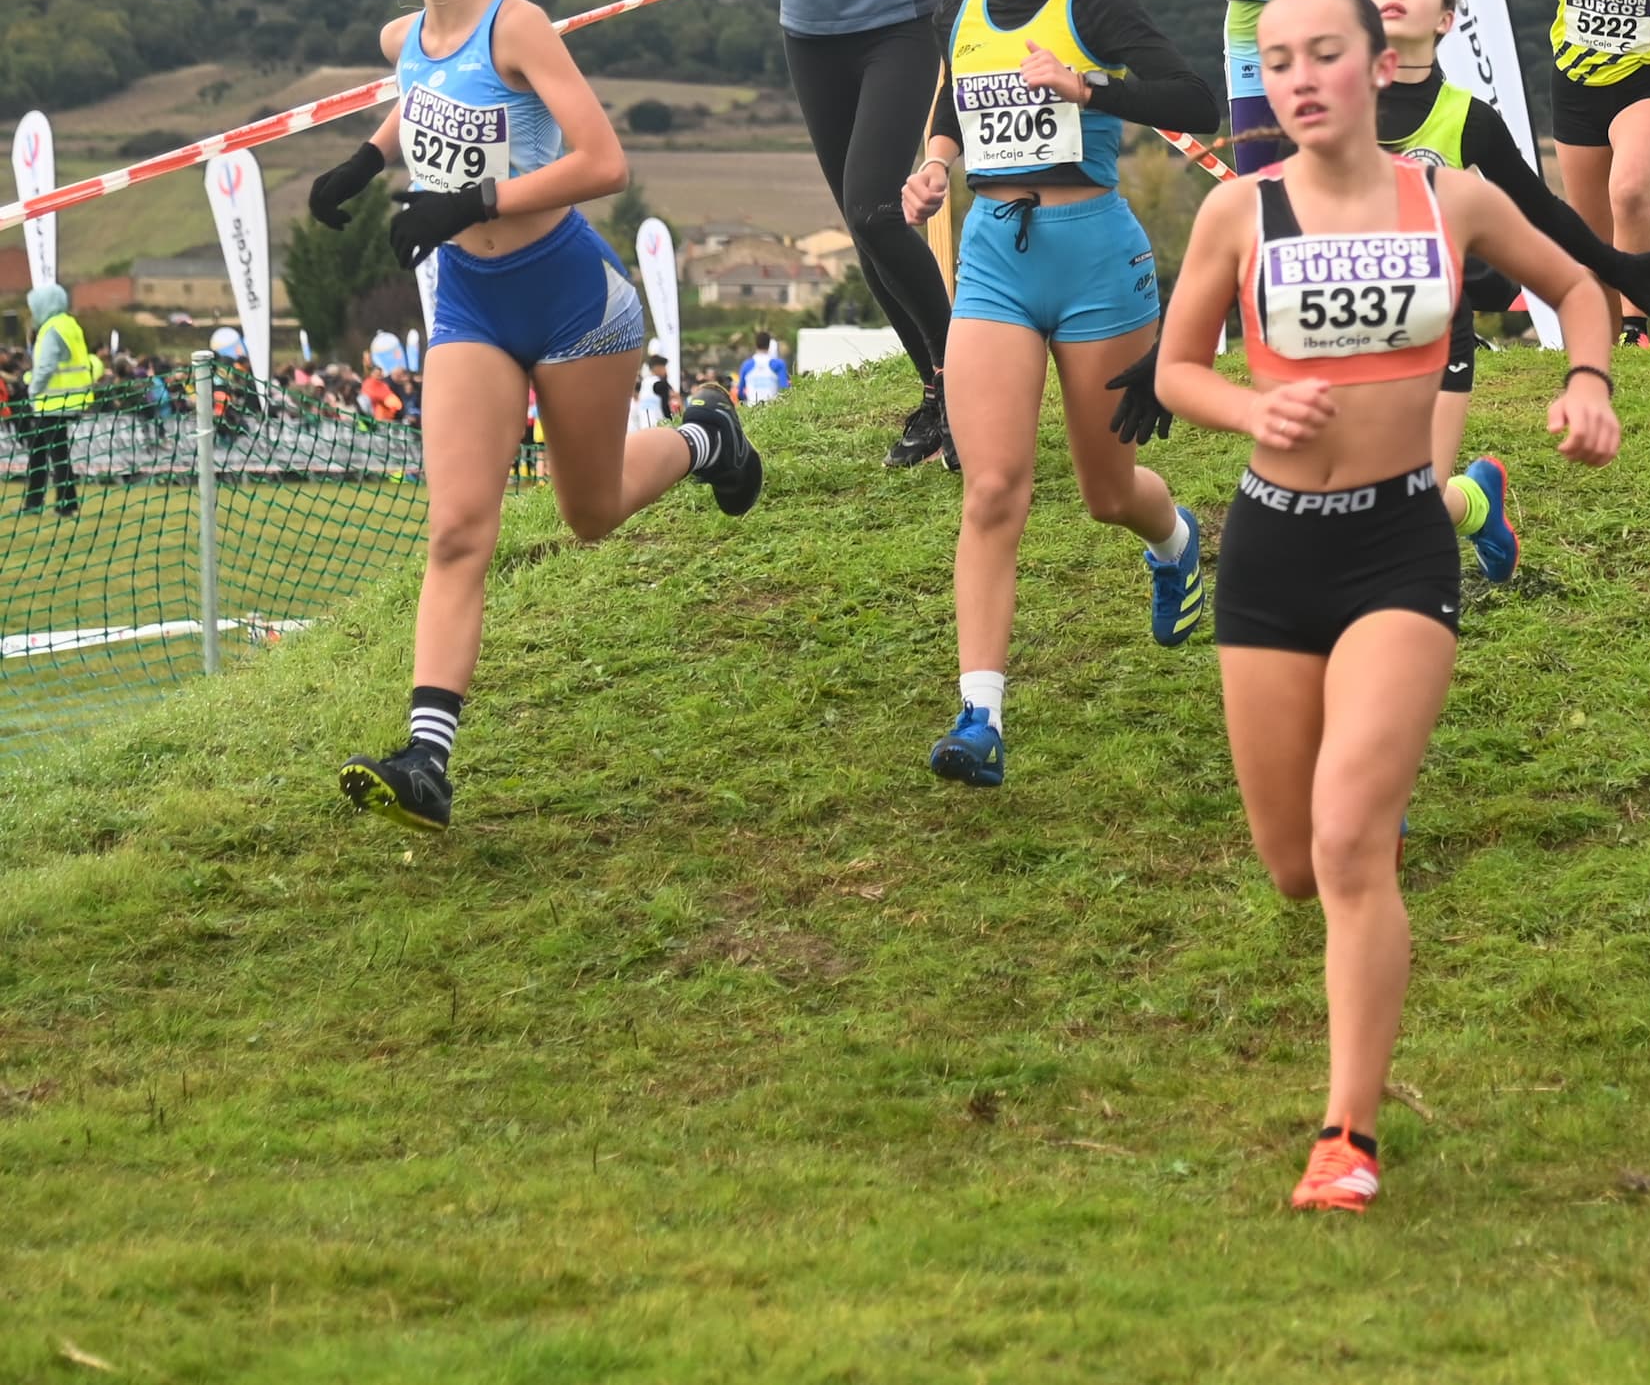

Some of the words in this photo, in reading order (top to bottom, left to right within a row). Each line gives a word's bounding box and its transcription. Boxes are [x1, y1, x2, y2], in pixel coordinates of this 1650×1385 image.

[1577, 11, 1638, 40] 5222
[408, 104, 498, 143] BURGOS
[413, 89, 498, 125] DIPUTACIÓN
[978, 107, 1058, 146] 5206
[411, 128, 487, 179] 5279
[983, 149, 1024, 162] iberCaja
[1280, 254, 1432, 284] BURGOS
[1299, 284, 1417, 331] 5337
[1303, 334, 1371, 349] iberCaja
[1239, 467, 1294, 513] NIKE
[1293, 485, 1377, 517] PRO
[1406, 464, 1437, 497] NI
